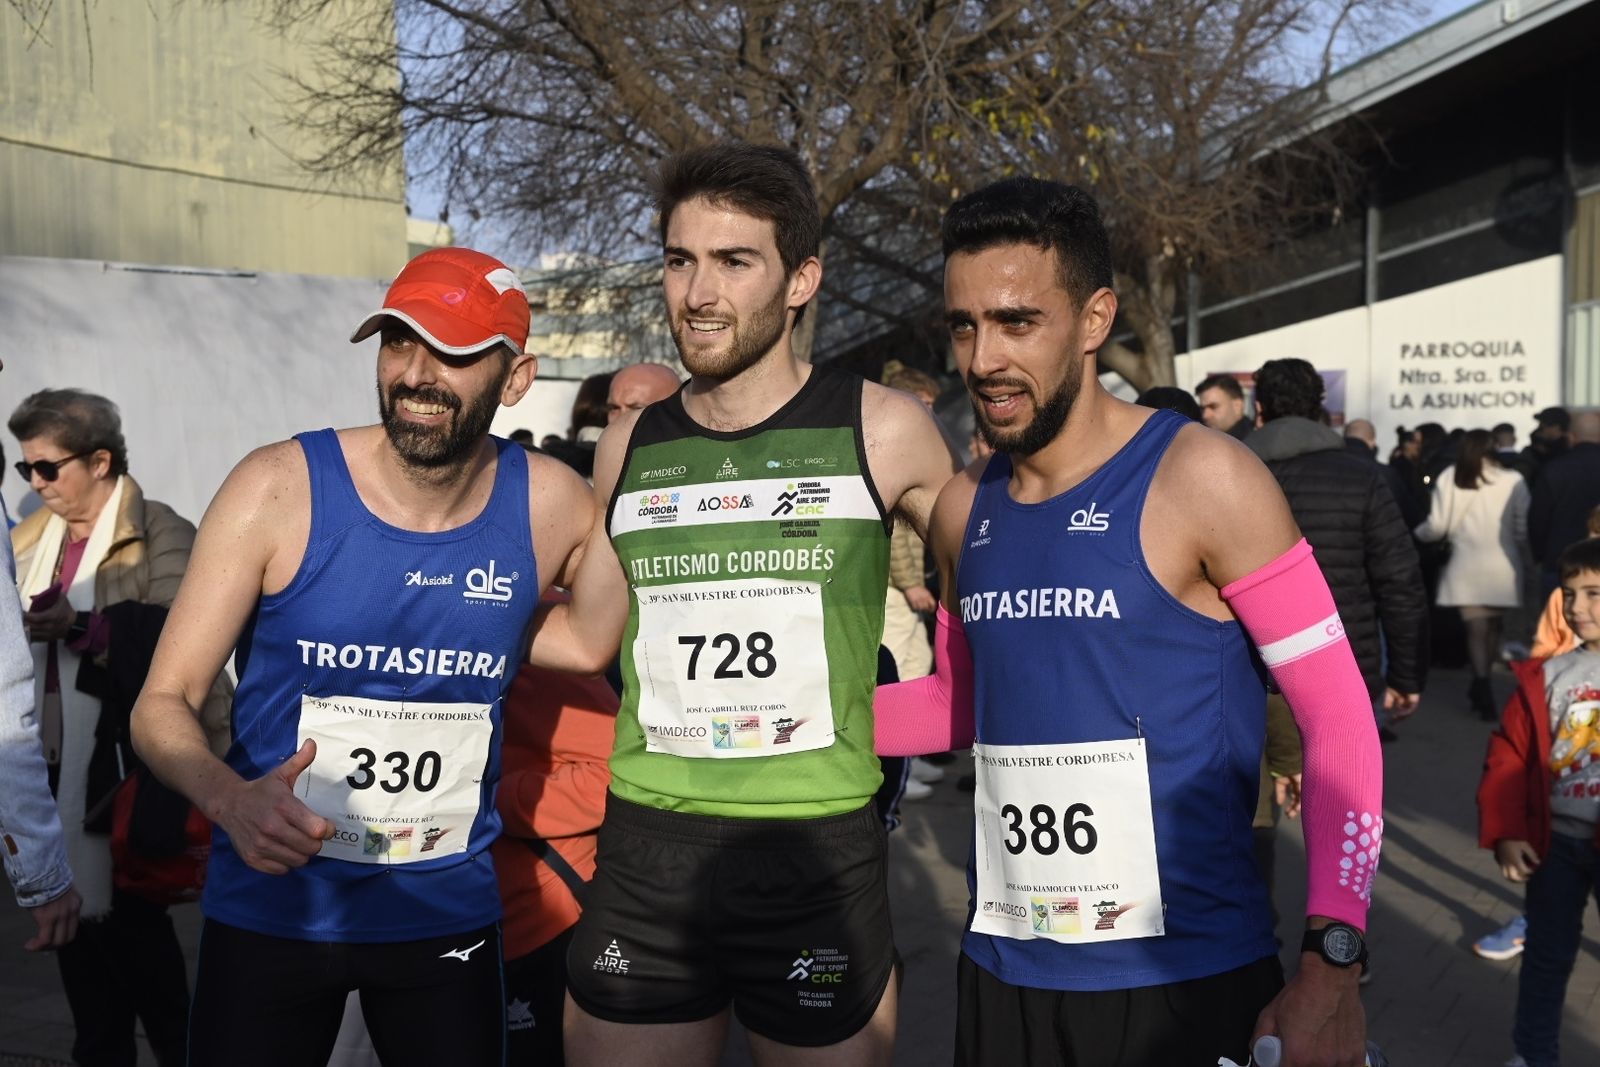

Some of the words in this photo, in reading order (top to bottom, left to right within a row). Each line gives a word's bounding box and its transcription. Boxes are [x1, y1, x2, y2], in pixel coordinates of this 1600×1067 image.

[1400, 340, 1525, 359] PARROQUIA
[1400, 369, 1448, 384] Ntra.
[1454, 368, 1492, 383] Sra.
[1500, 366, 1526, 382] DE
[1390, 394, 1413, 410] LA
[1422, 391, 1534, 409] ASUNCION
[781, 458, 800, 468] LSC
[650, 465, 687, 478] IMDECO
[716, 467, 739, 476] AIRE
[697, 495, 750, 511] AOSSA
[811, 496, 830, 504] SPORT
[638, 504, 679, 517] CÓRDOBA
[795, 505, 825, 515] CAC
[1067, 502, 1110, 531] als
[781, 528, 818, 538] CÓRDOBA
[631, 552, 720, 581] ATLETISMO
[727, 544, 835, 574] CORDOBÉS
[463, 560, 513, 602] als
[661, 593, 680, 603] SAN
[679, 589, 738, 603] SILVESTRE
[740, 585, 812, 599] CORDOBESA
[959, 587, 1121, 624] TROTASIERRA
[296, 639, 507, 680] TROTASIERRA
[677, 631, 777, 681] 728
[333, 703, 356, 714] SAN
[357, 706, 419, 721] SILVESTRE
[421, 712, 484, 721] CORDOBESA
[704, 705, 739, 713] GABRIEL
[740, 704, 758, 712] RUIZ
[759, 703, 787, 711] COBOS
[659, 726, 707, 738] IMDECO
[997, 756, 1054, 768] SILVESTRE
[1056, 752, 1135, 766] CORDOBESA
[346, 747, 442, 794] 330
[345, 813, 378, 823] ALVARO
[379, 816, 420, 824] GONZALEZ
[1001, 803, 1098, 856] 386
[1016, 884, 1032, 892] SAID
[1033, 884, 1077, 893] KIAMOUCH
[1077, 883, 1119, 892] VELASCO
[994, 901, 1027, 918] IMDECO
[594, 955, 630, 971] AIRE
[811, 964, 826, 972] AIRE
[828, 963, 849, 972] SPORT
[811, 973, 842, 983] CAC
